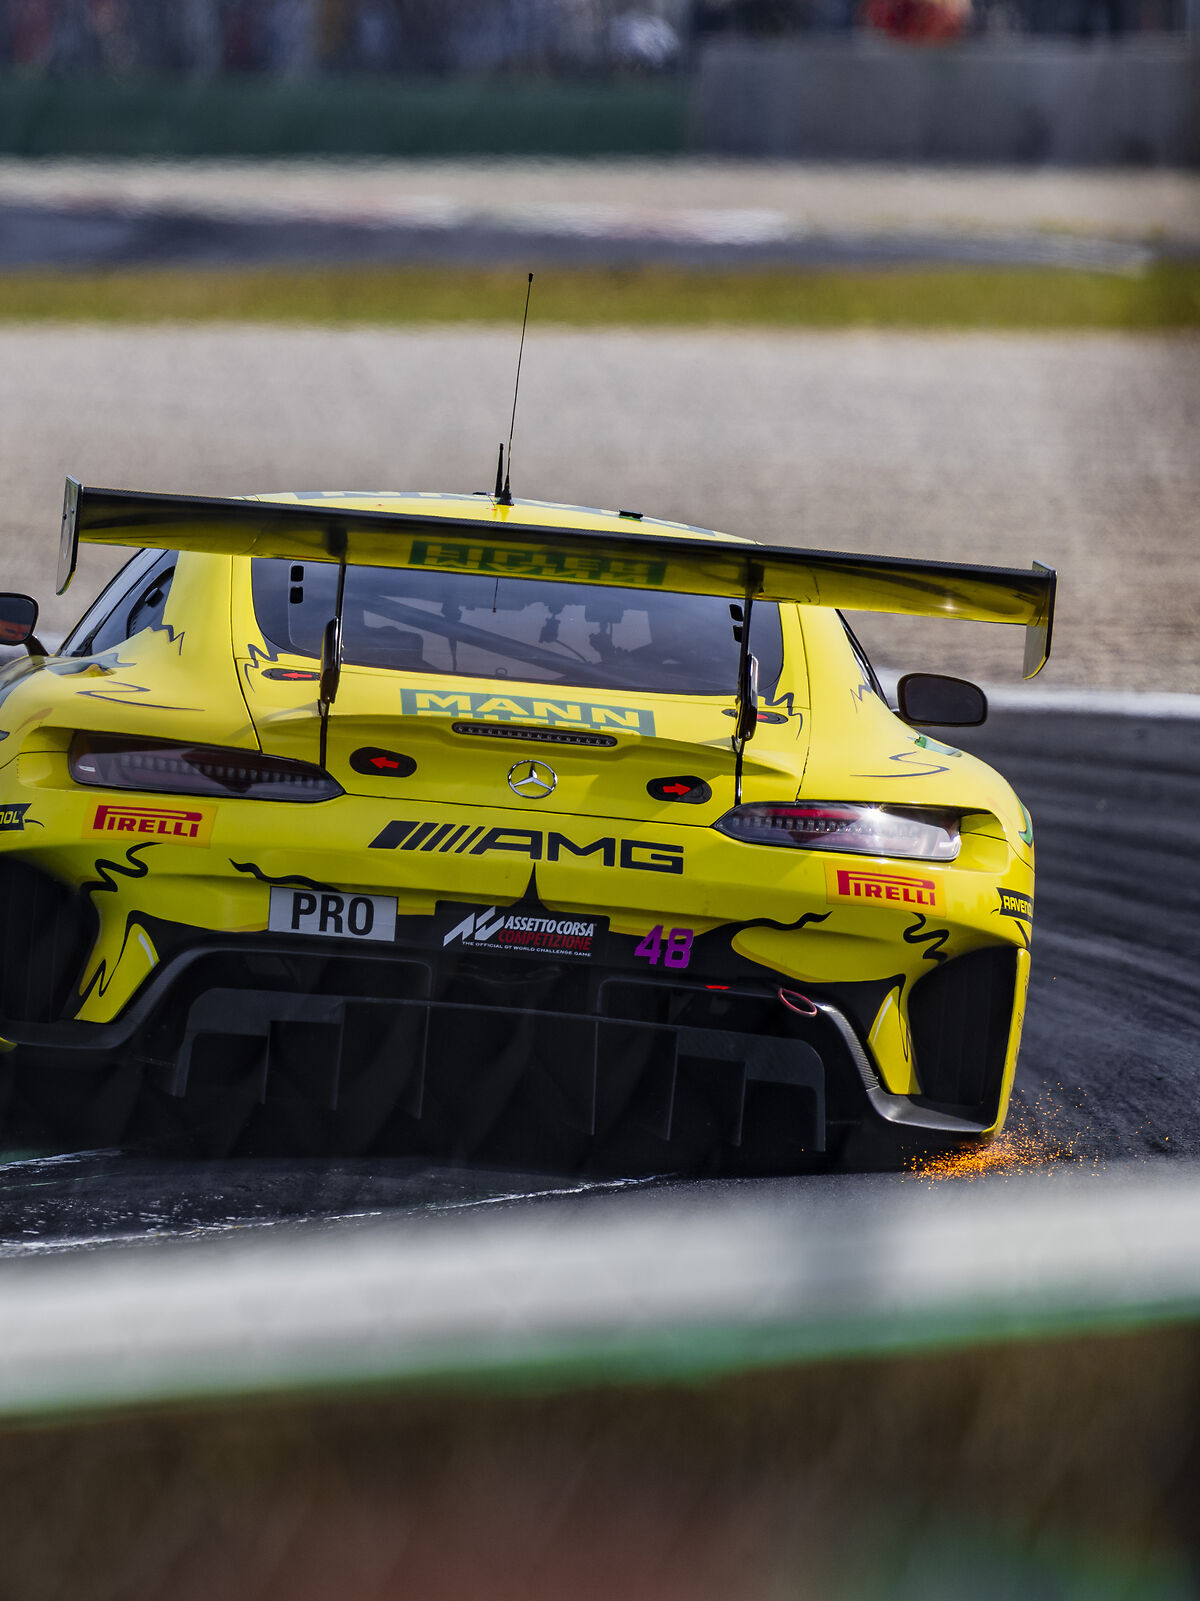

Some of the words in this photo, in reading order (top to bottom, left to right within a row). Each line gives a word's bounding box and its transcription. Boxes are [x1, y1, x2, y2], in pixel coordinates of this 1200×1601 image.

[416, 692, 640, 728] MANN
[93, 805, 203, 838] PIRELLI
[469, 827, 685, 875] AMG
[836, 870, 936, 906] PIRELLI
[291, 892, 375, 936] PRO
[504, 915, 557, 933] ASSETTO
[556, 920, 594, 937] CORSA
[498, 929, 593, 951] COMPETIZIONE
[536, 947, 573, 955] CHALLENGE
[634, 924, 694, 969] 48
